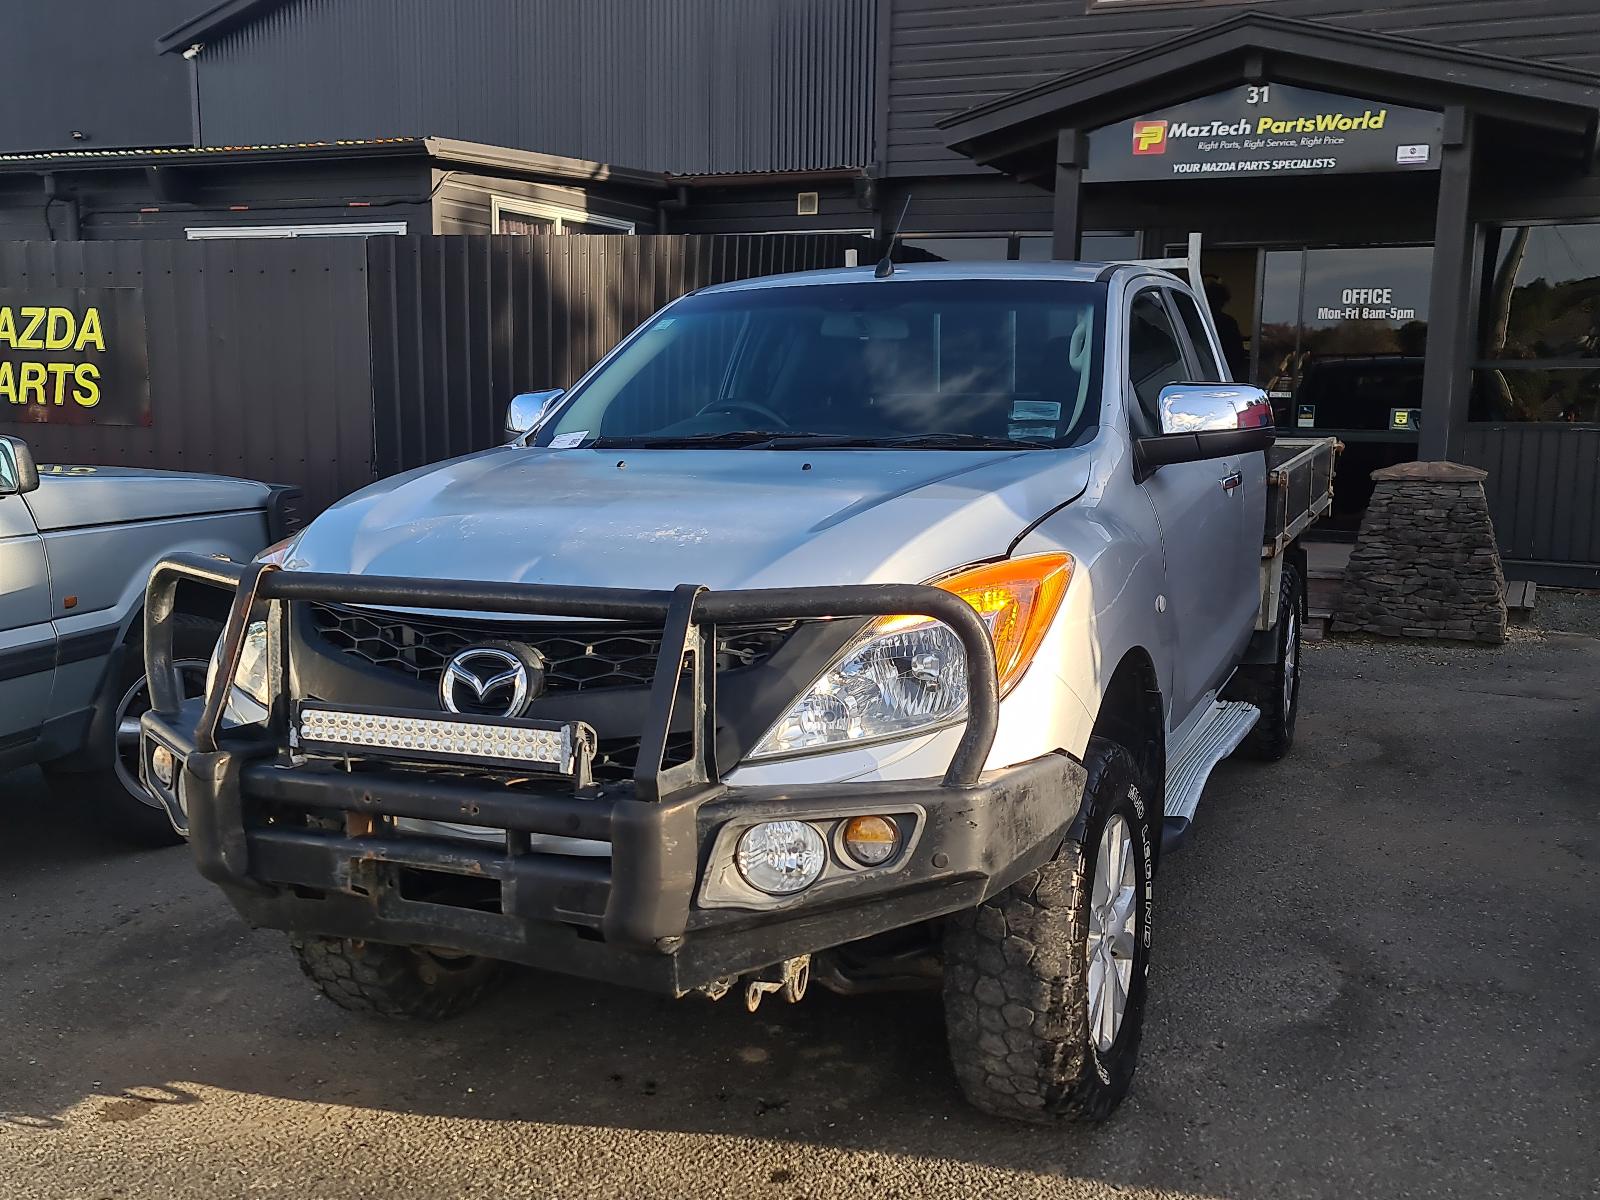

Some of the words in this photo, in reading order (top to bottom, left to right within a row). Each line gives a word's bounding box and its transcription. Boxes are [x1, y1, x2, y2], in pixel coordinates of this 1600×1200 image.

[1246, 86, 1270, 104] 31
[1168, 118, 1251, 138] MazTech
[1256, 110, 1387, 135] PartsWorld
[1198, 141, 1219, 151] Right
[1219, 139, 1241, 150] Parts,
[1243, 138, 1265, 149] Right
[1266, 137, 1298, 147] Service,
[1300, 135, 1322, 147] Right
[1323, 135, 1345, 145] Price
[1173, 163, 1200, 173] YOUR
[1201, 161, 1236, 173] MAZDA
[1237, 160, 1271, 171] PARTS
[1271, 157, 1337, 170] SPECIALISTS
[1342, 288, 1392, 304] OFFICE
[1317, 307, 1360, 320] Mon-Fri
[1362, 307, 1415, 321] 8am-5pm
